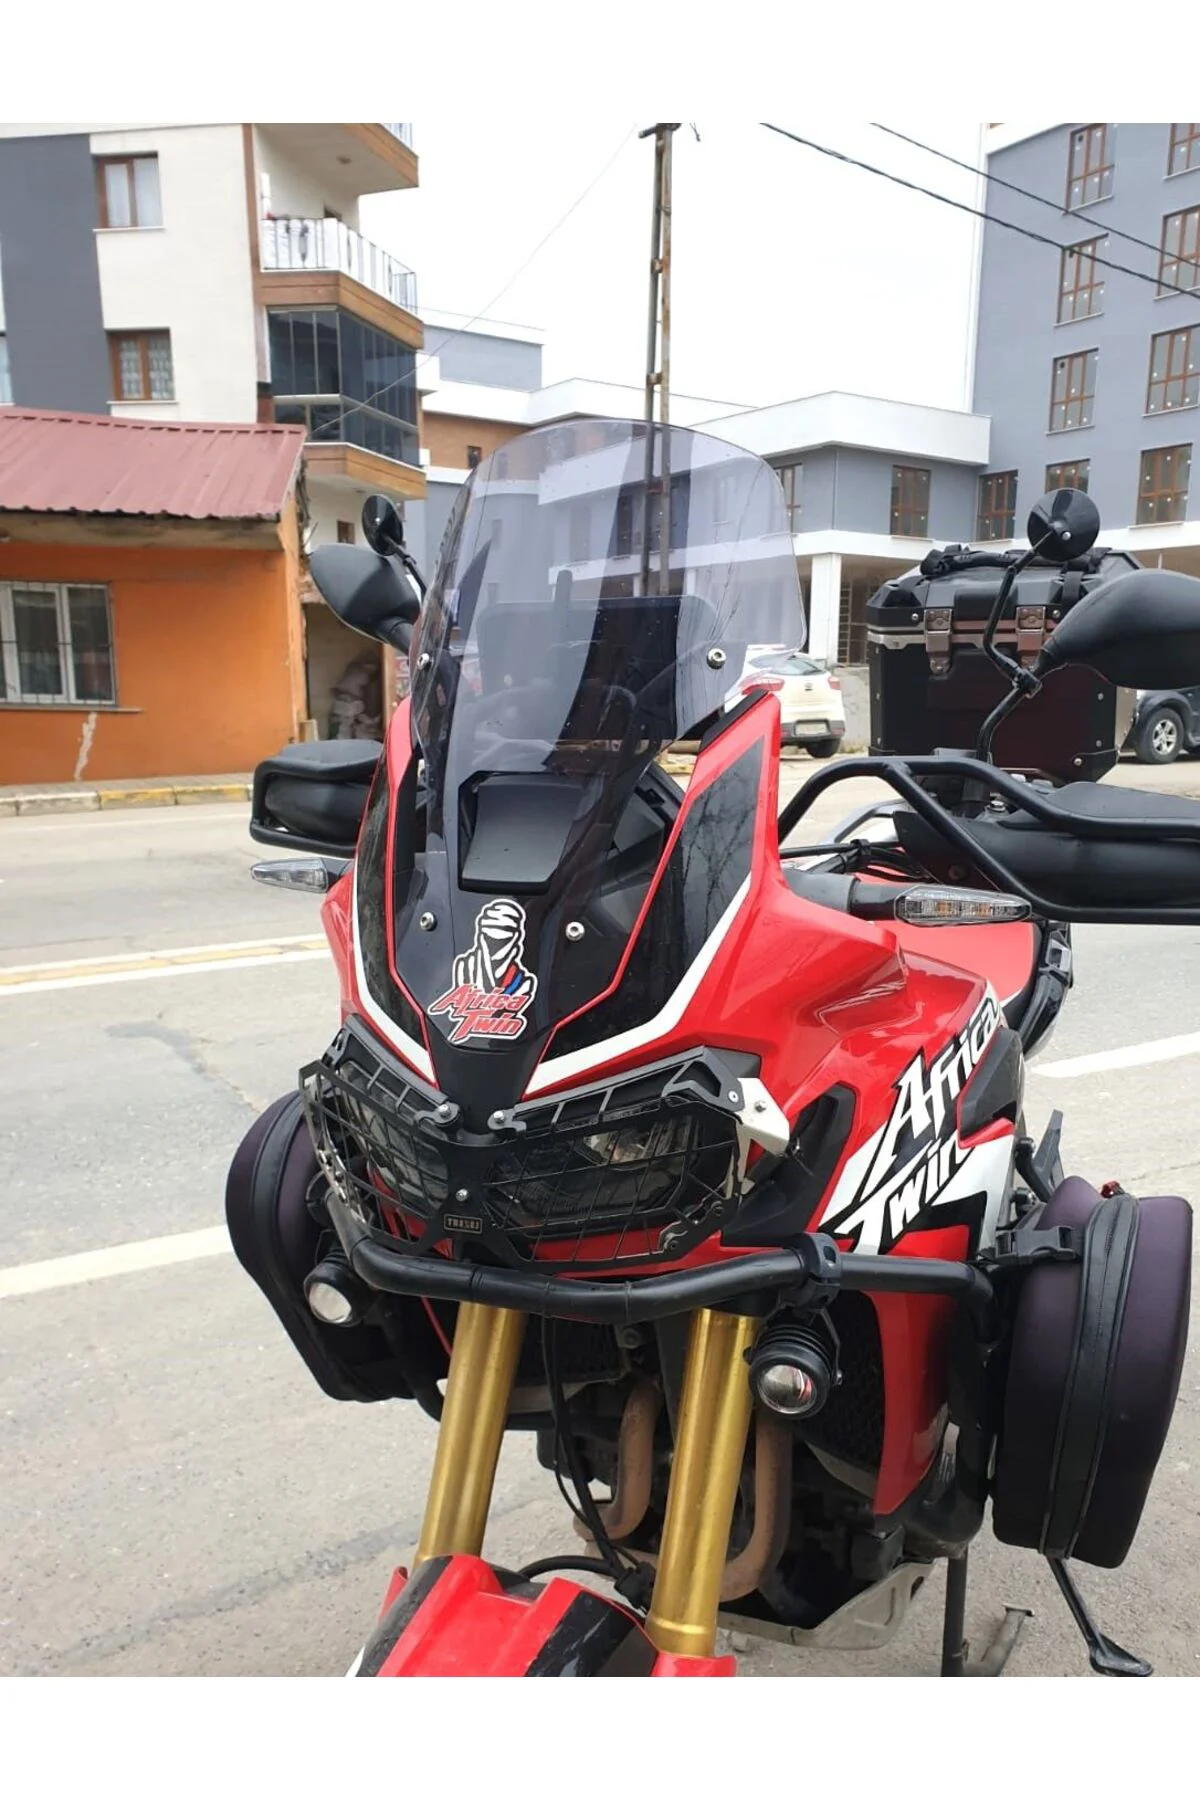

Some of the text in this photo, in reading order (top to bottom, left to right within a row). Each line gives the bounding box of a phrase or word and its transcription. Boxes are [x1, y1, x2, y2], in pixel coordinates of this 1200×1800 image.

[431, 983, 530, 1016] Africa
[452, 1008, 523, 1040] Twin
[859, 1001, 999, 1202] Africa
